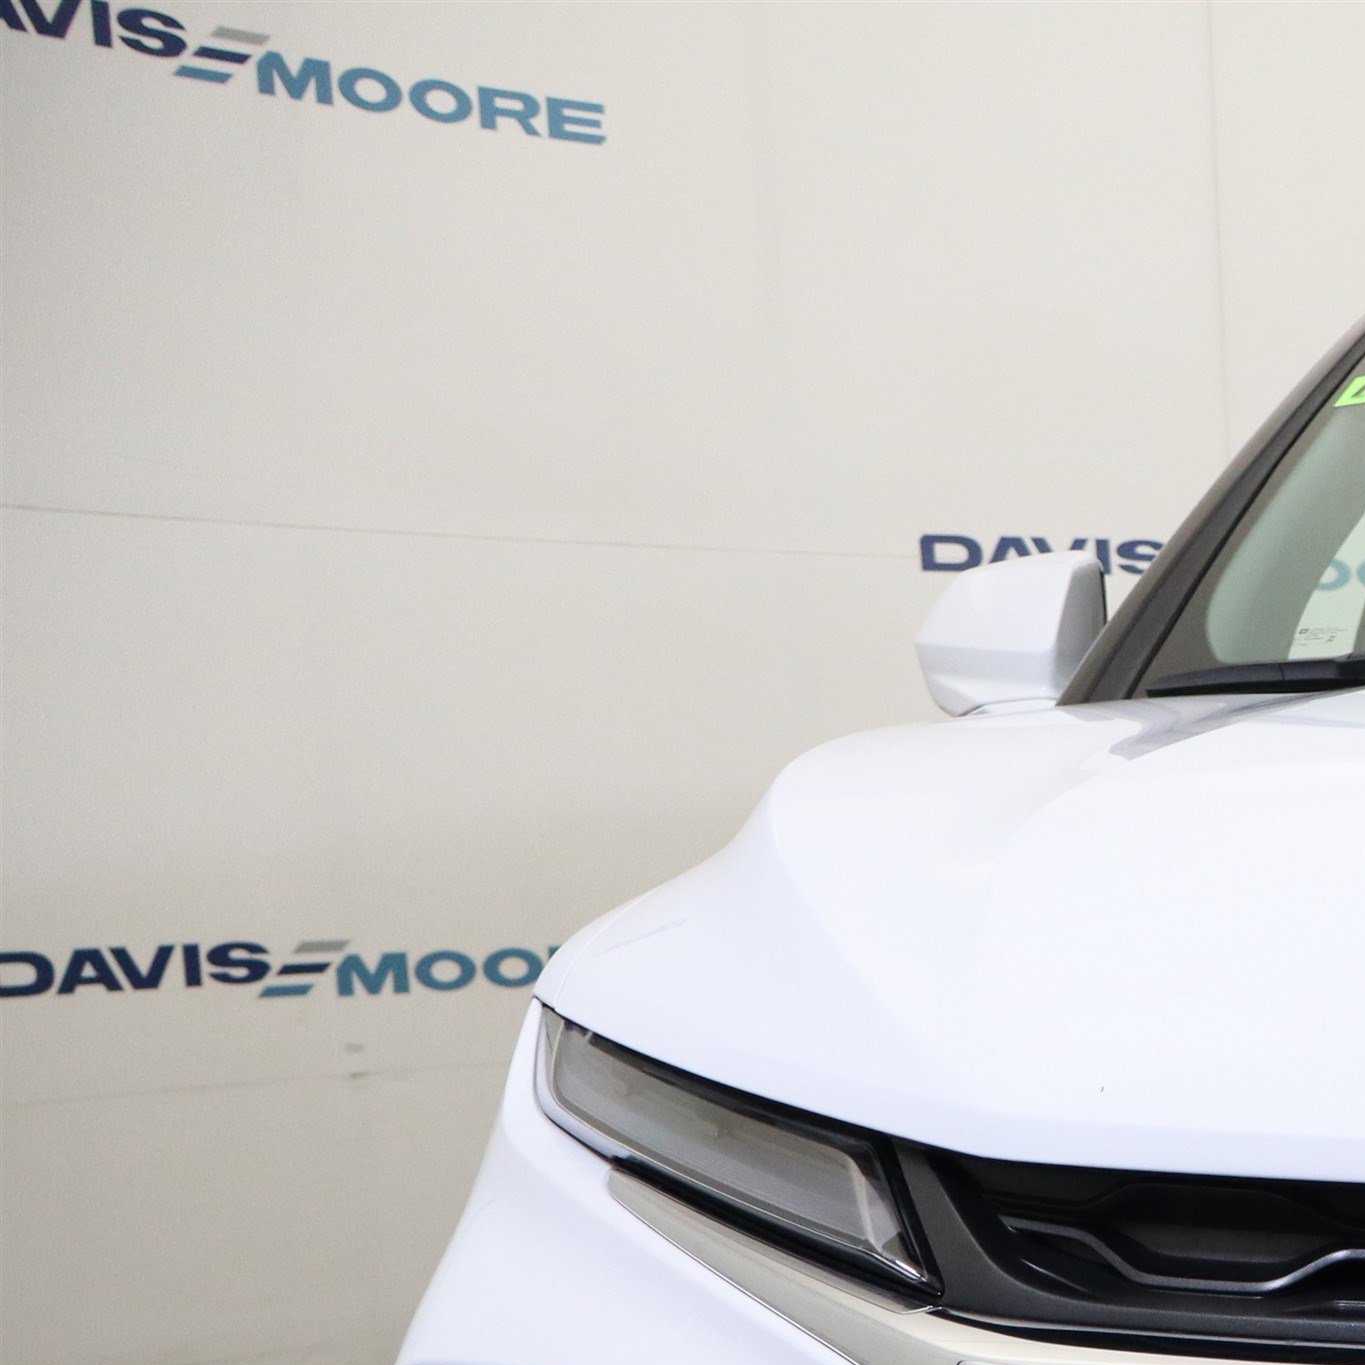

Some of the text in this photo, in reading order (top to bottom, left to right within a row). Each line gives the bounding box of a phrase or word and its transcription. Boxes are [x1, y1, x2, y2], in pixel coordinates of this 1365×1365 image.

[0, 0, 607, 146] VIS MOORE
[0, 942, 561, 997] DAVIS MOO
